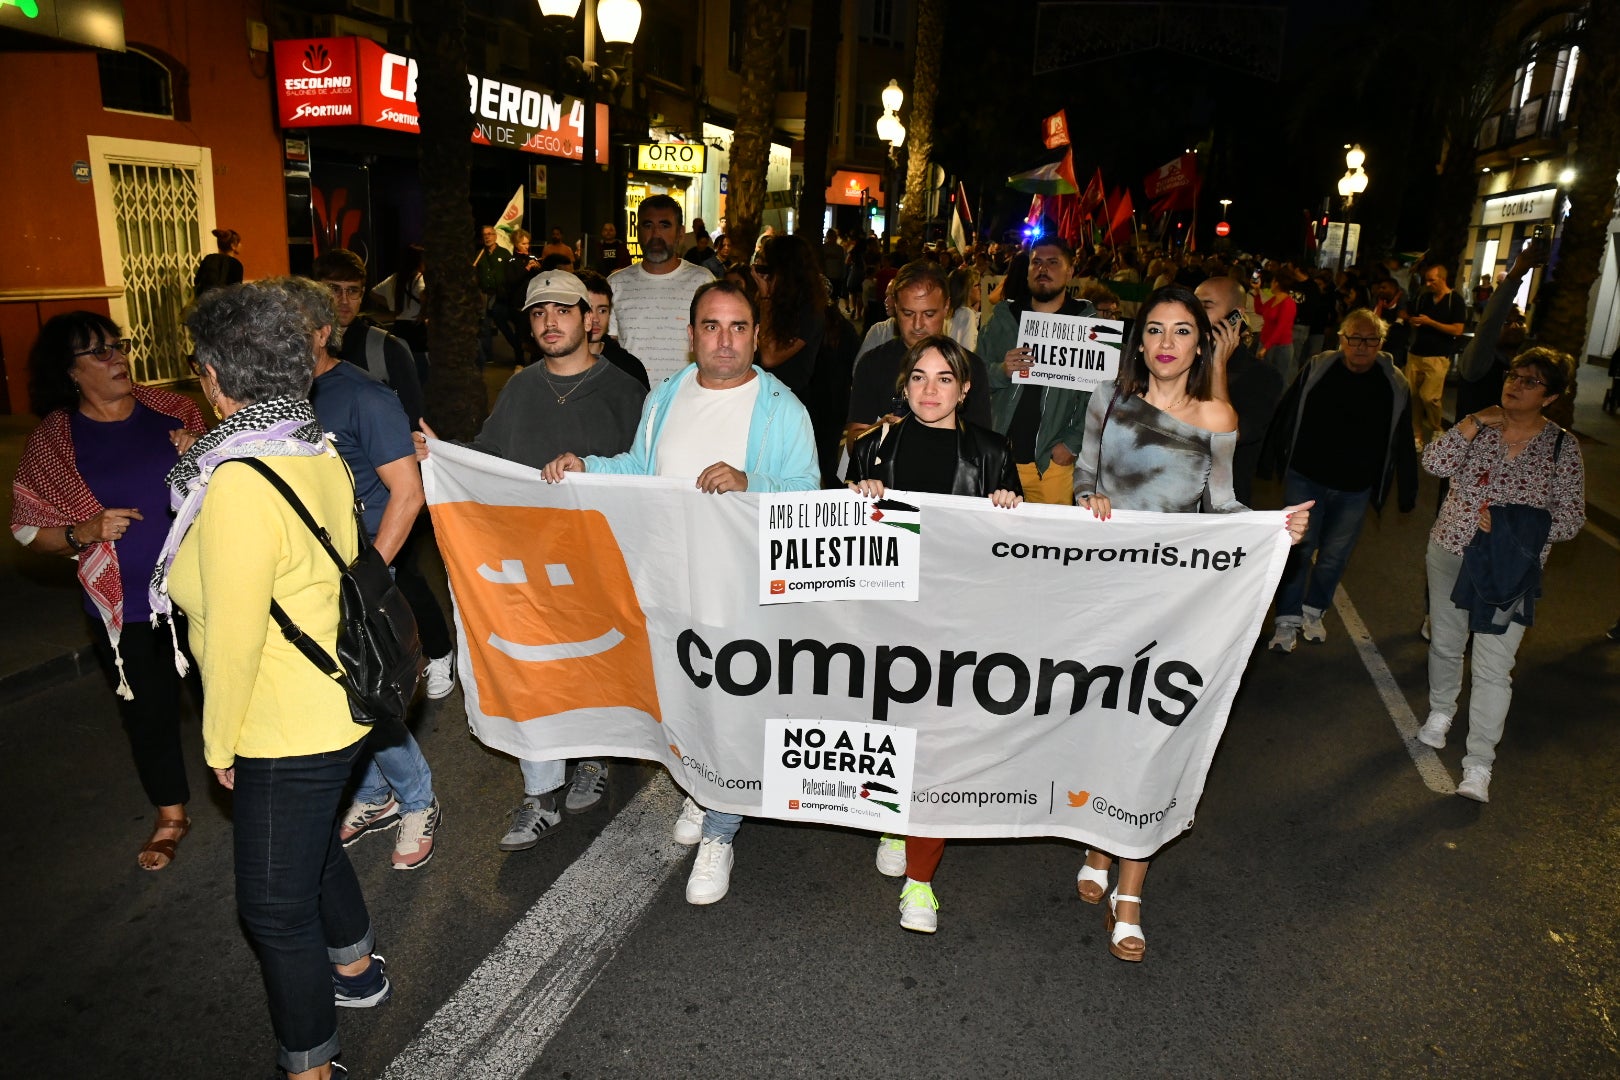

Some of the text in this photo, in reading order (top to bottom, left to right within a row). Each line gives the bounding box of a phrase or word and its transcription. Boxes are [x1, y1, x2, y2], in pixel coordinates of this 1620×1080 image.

[284, 76, 352, 90] ESCOLANO
[286, 88, 317, 97] SALONES
[330, 87, 353, 95] JUEGO
[289, 102, 352, 121] SPORTIUM
[568, 99, 584, 138] 4
[496, 126, 515, 145] DE
[520, 132, 561, 152] JUEGO
[649, 144, 693, 162] ORO
[1501, 200, 1534, 217] COCINAS
[1023, 319, 1088, 342] AMB EL POBLE DE
[769, 501, 868, 529] AMB EL POBLE DE
[770, 536, 899, 570] PALESTINA
[991, 542, 1247, 572] compromis.net
[788, 576, 905, 592] compromís Crevillent
[676, 628, 1204, 727] compromís
[784, 728, 897, 756] NO A LA
[681, 755, 762, 790] coaliciocom
[781, 749, 896, 778] GUERRA
[802, 778, 836, 797] Palestina
